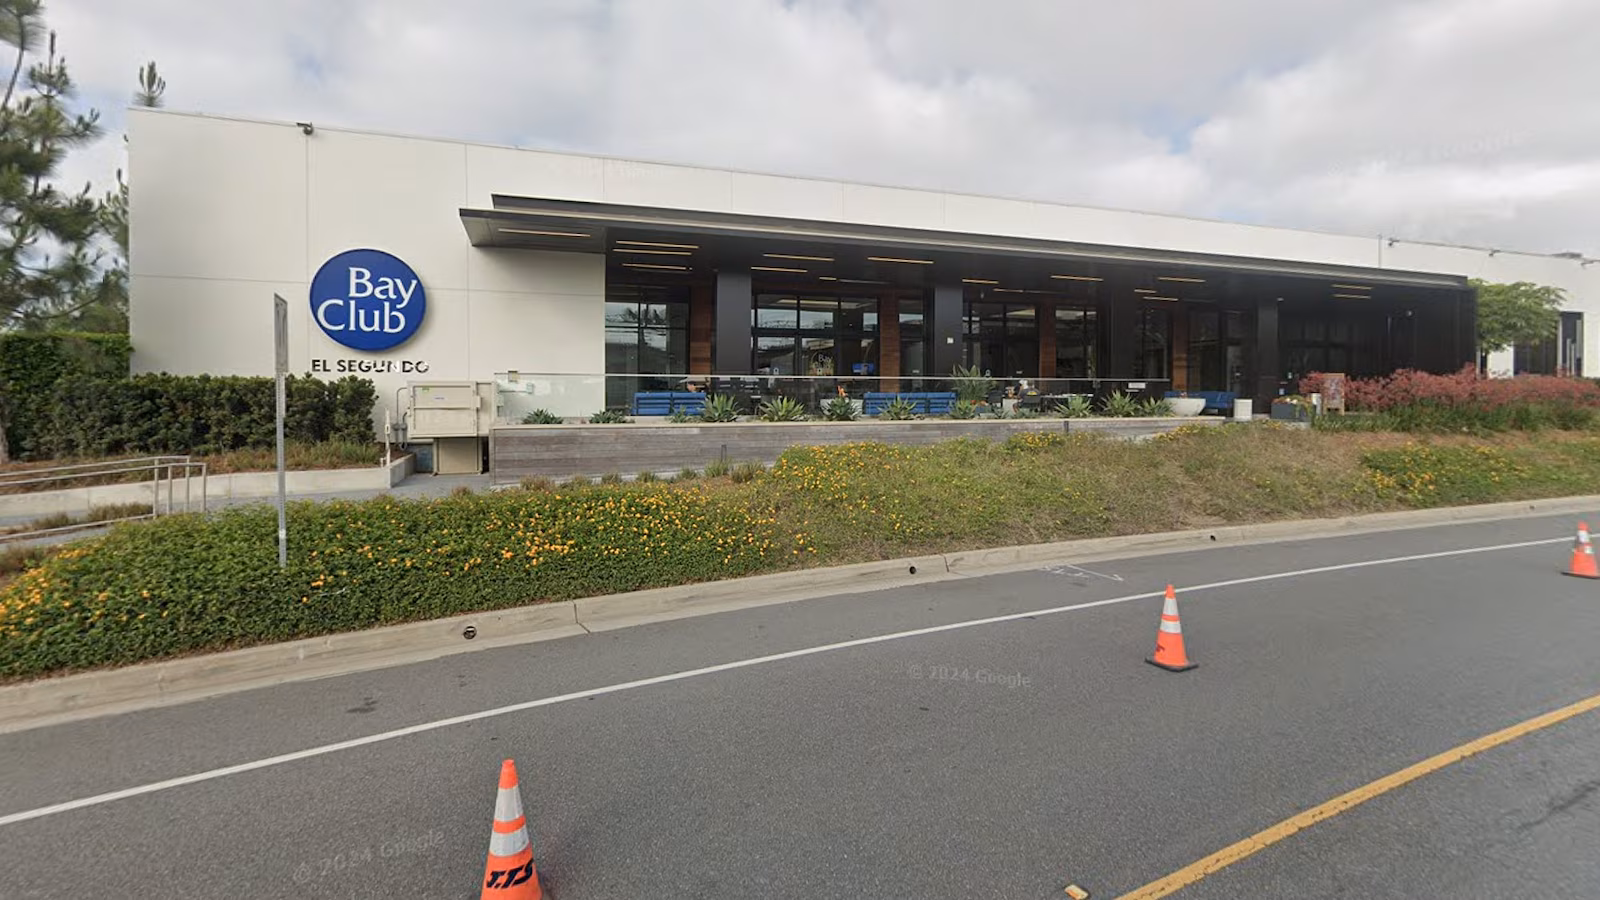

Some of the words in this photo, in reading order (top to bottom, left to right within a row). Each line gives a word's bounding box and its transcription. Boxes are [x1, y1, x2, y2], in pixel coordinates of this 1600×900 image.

[349, 267, 417, 308] Bay
[317, 298, 406, 333] Club
[311, 359, 331, 372] EL
[336, 359, 429, 374] SEGUNDO
